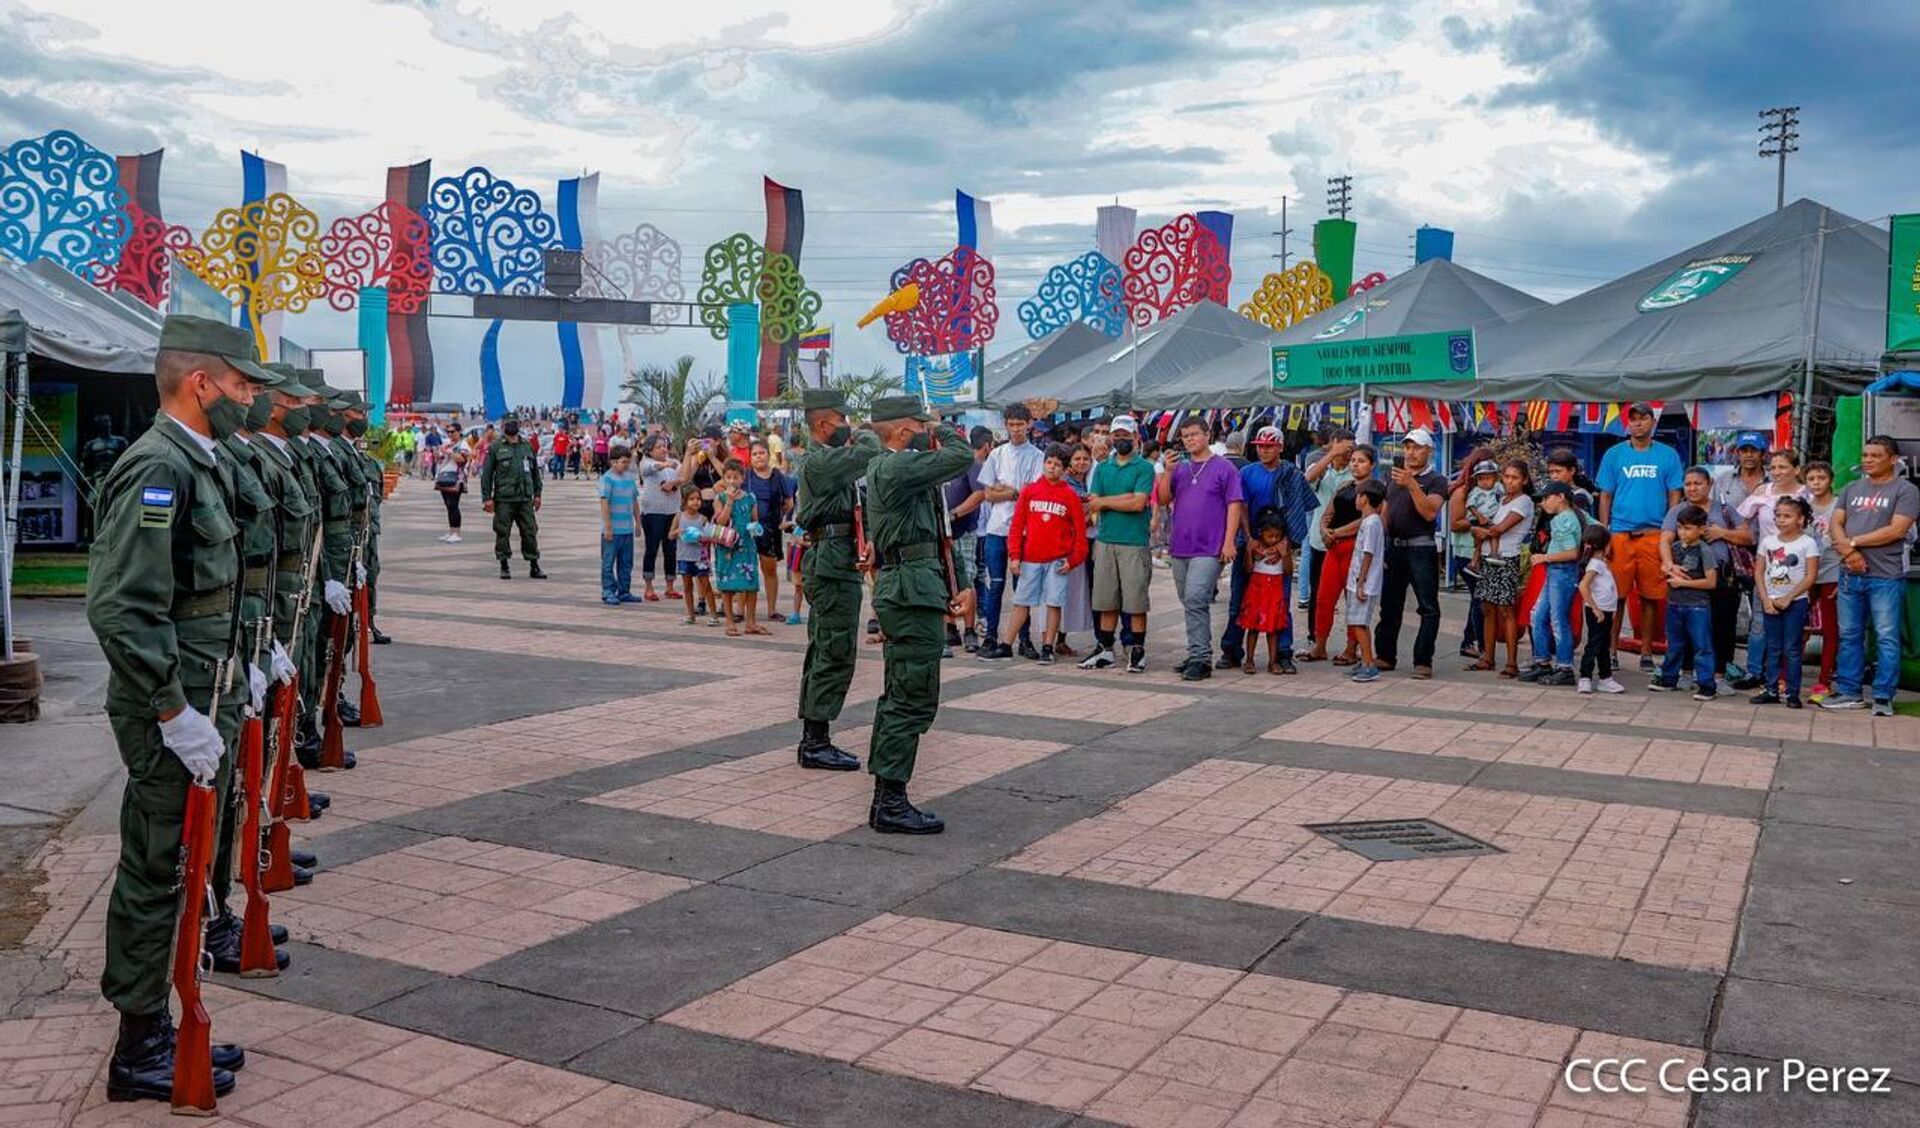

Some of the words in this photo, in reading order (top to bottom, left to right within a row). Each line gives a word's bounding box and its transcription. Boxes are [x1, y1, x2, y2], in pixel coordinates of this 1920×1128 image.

[1315, 347, 1350, 361] NAVALES
[1352, 344, 1371, 358] POR
[1322, 366, 1343, 379] TODO
[1344, 364, 1363, 378] POR
[1364, 363, 1376, 377] LA
[1378, 361, 1413, 376] PATRIA
[1622, 464, 1658, 479] VANS
